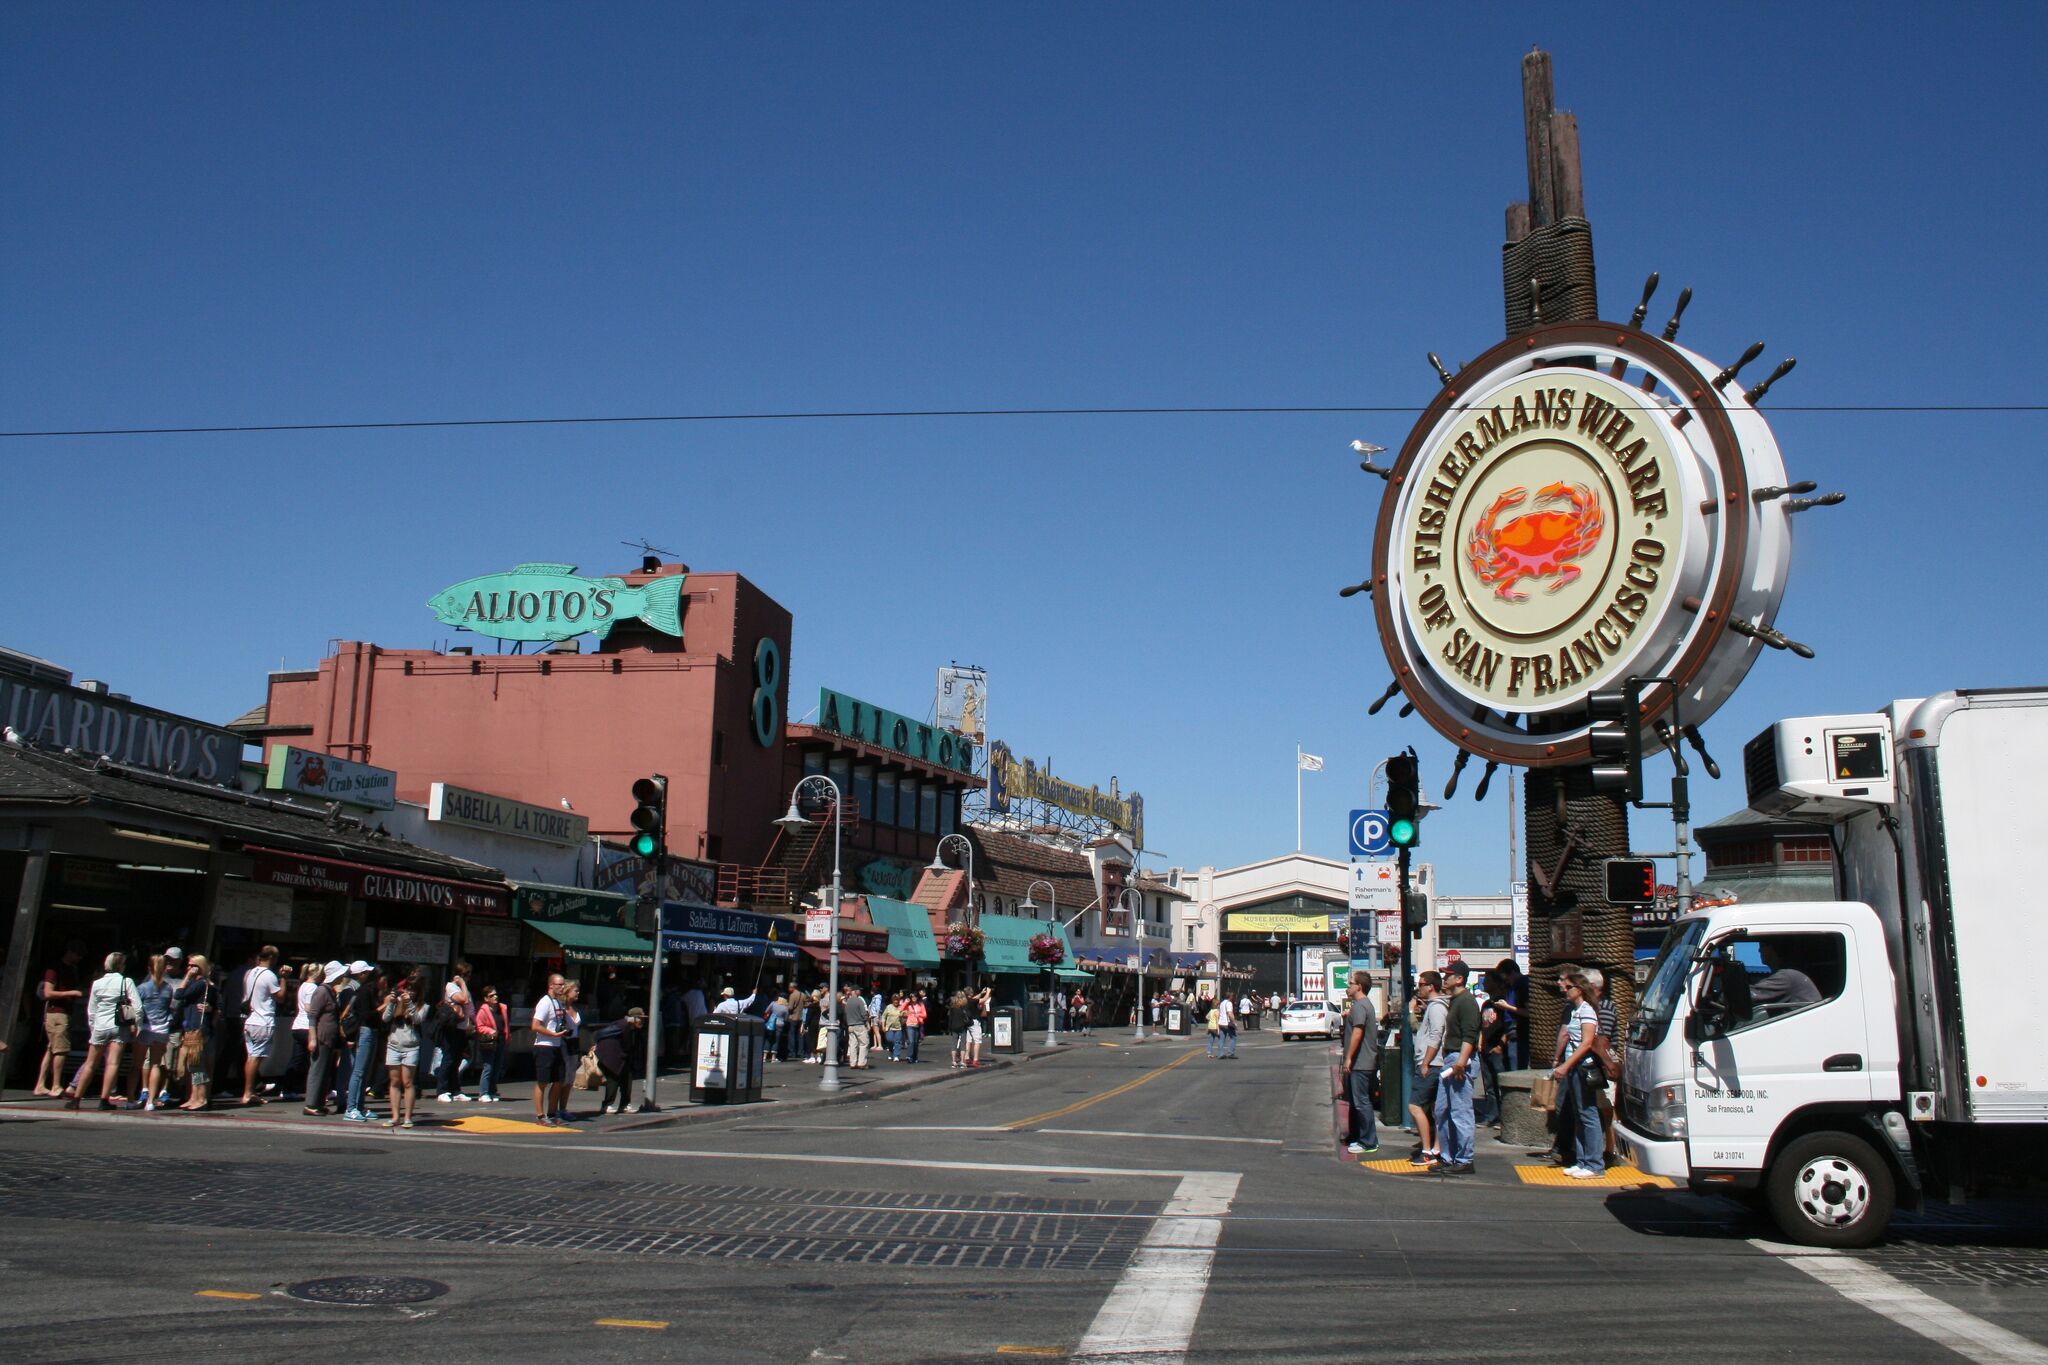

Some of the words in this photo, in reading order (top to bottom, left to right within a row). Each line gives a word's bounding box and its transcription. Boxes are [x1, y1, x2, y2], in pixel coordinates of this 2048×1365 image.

[1413, 387, 1576, 573] FISHERMANS
[1577, 391, 1670, 521] WHARF
[463, 586, 616, 622] ALIOTO'S
[1418, 582, 1458, 634] OF
[1441, 626, 1503, 688] SAN
[1507, 537, 1668, 698] FRANCISCO
[752, 637, 780, 748] 8
[0, 680, 221, 780] UARDINO'S
[822, 693, 974, 773] ALIOTO'S
[328, 776, 353, 793] Crab
[354, 773, 389, 790] Station
[445, 792, 501, 826] SABELLA
[514, 808, 529, 831] LA
[533, 811, 571, 839] TORRE
[1363, 820, 1383, 846] P
[364, 874, 453, 907] GUARDINO'S
[688, 911, 717, 930] Sabella
[1694, 1089, 1725, 1098] FLANNERY
[1726, 1089, 1756, 1100] SEAFOOD,
[1756, 1090, 1769, 1099] INC.
[1707, 1105, 1718, 1113] San
[1718, 1105, 1746, 1114] Francisco,
[1746, 1105, 1754, 1113] CA
[1713, 1151, 1724, 1159] CA#
[1725, 1151, 1745, 1160] 310741
